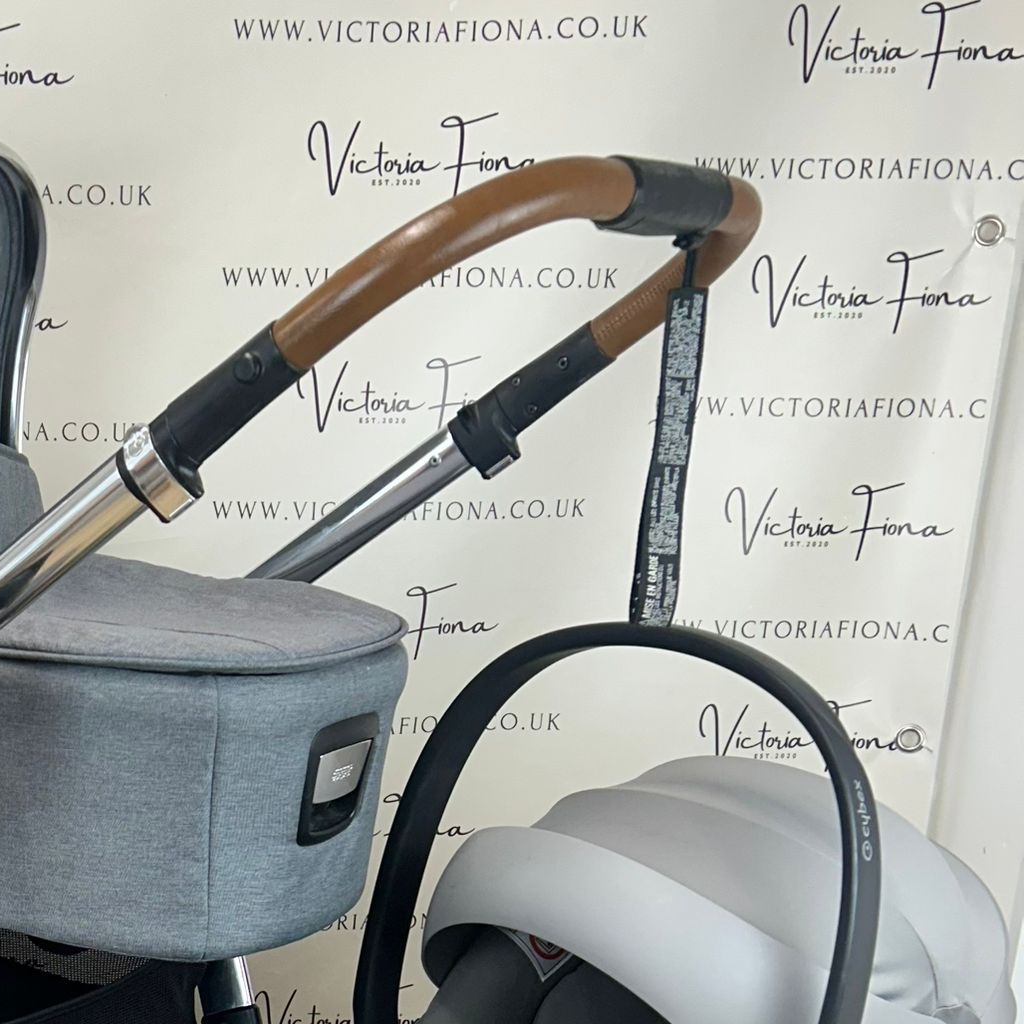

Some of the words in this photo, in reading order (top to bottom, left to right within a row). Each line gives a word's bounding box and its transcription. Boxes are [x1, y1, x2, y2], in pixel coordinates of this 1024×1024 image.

[233, 15, 648, 44] WWW.VICTORIAFIONA.CO.UK
[787, 3, 919, 85] Victoria
[920, 0, 1024, 89] Fiona
[844, 66, 897, 75] EST.2020
[307, 119, 443, 197] Victoria
[371, 178, 421, 187] EST.2020
[751, 254, 885, 329] Victoria
[886, 249, 992, 334] Fiona
[813, 311, 863, 320] EST.2020
[296, 361, 427, 434] Victoria
[358, 416, 406, 425] EST.2020
[724, 486, 849, 556] Victoria
[851, 482, 955, 561] Fiona
[783, 540, 829, 548] EST.2020
[405, 582, 499, 661] Fiona
[699, 704, 814, 755] Victoria
